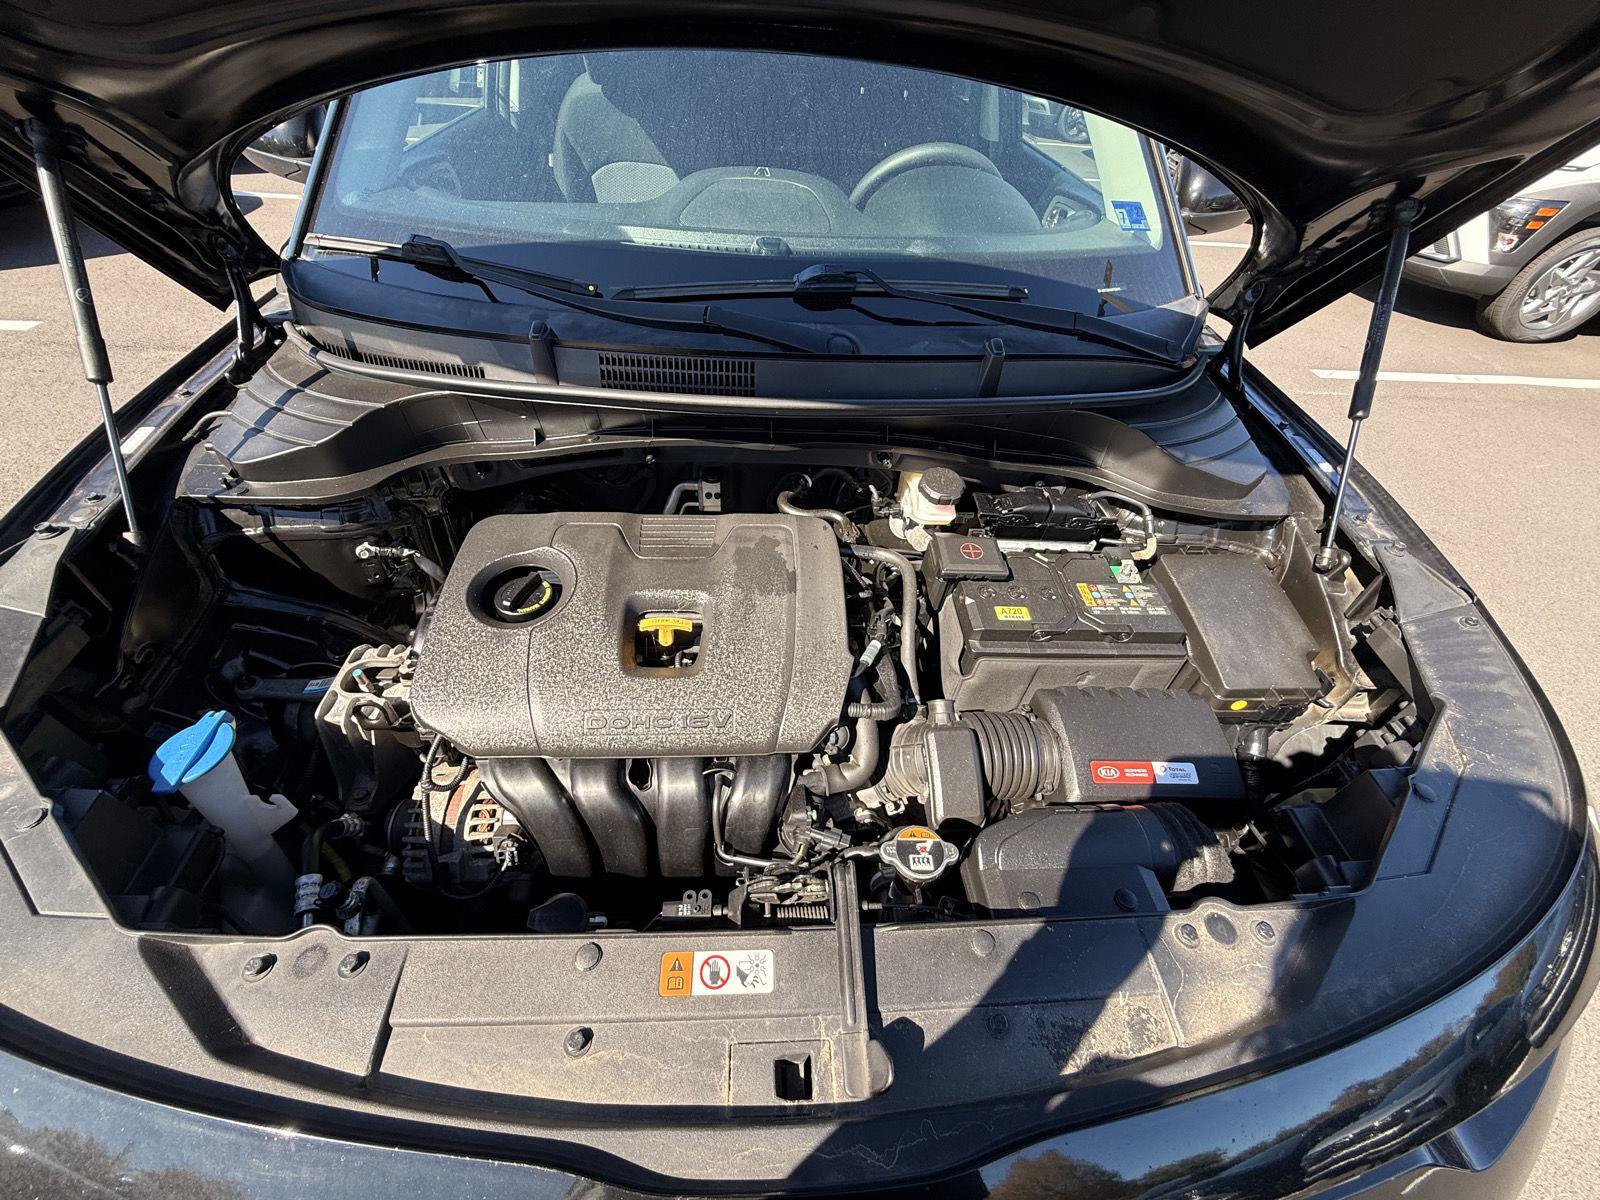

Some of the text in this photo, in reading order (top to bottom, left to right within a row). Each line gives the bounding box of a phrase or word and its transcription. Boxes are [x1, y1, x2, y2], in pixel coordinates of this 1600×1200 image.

[586, 713, 732, 729] DOHC 16V
[1100, 768, 1117, 777] KIA
